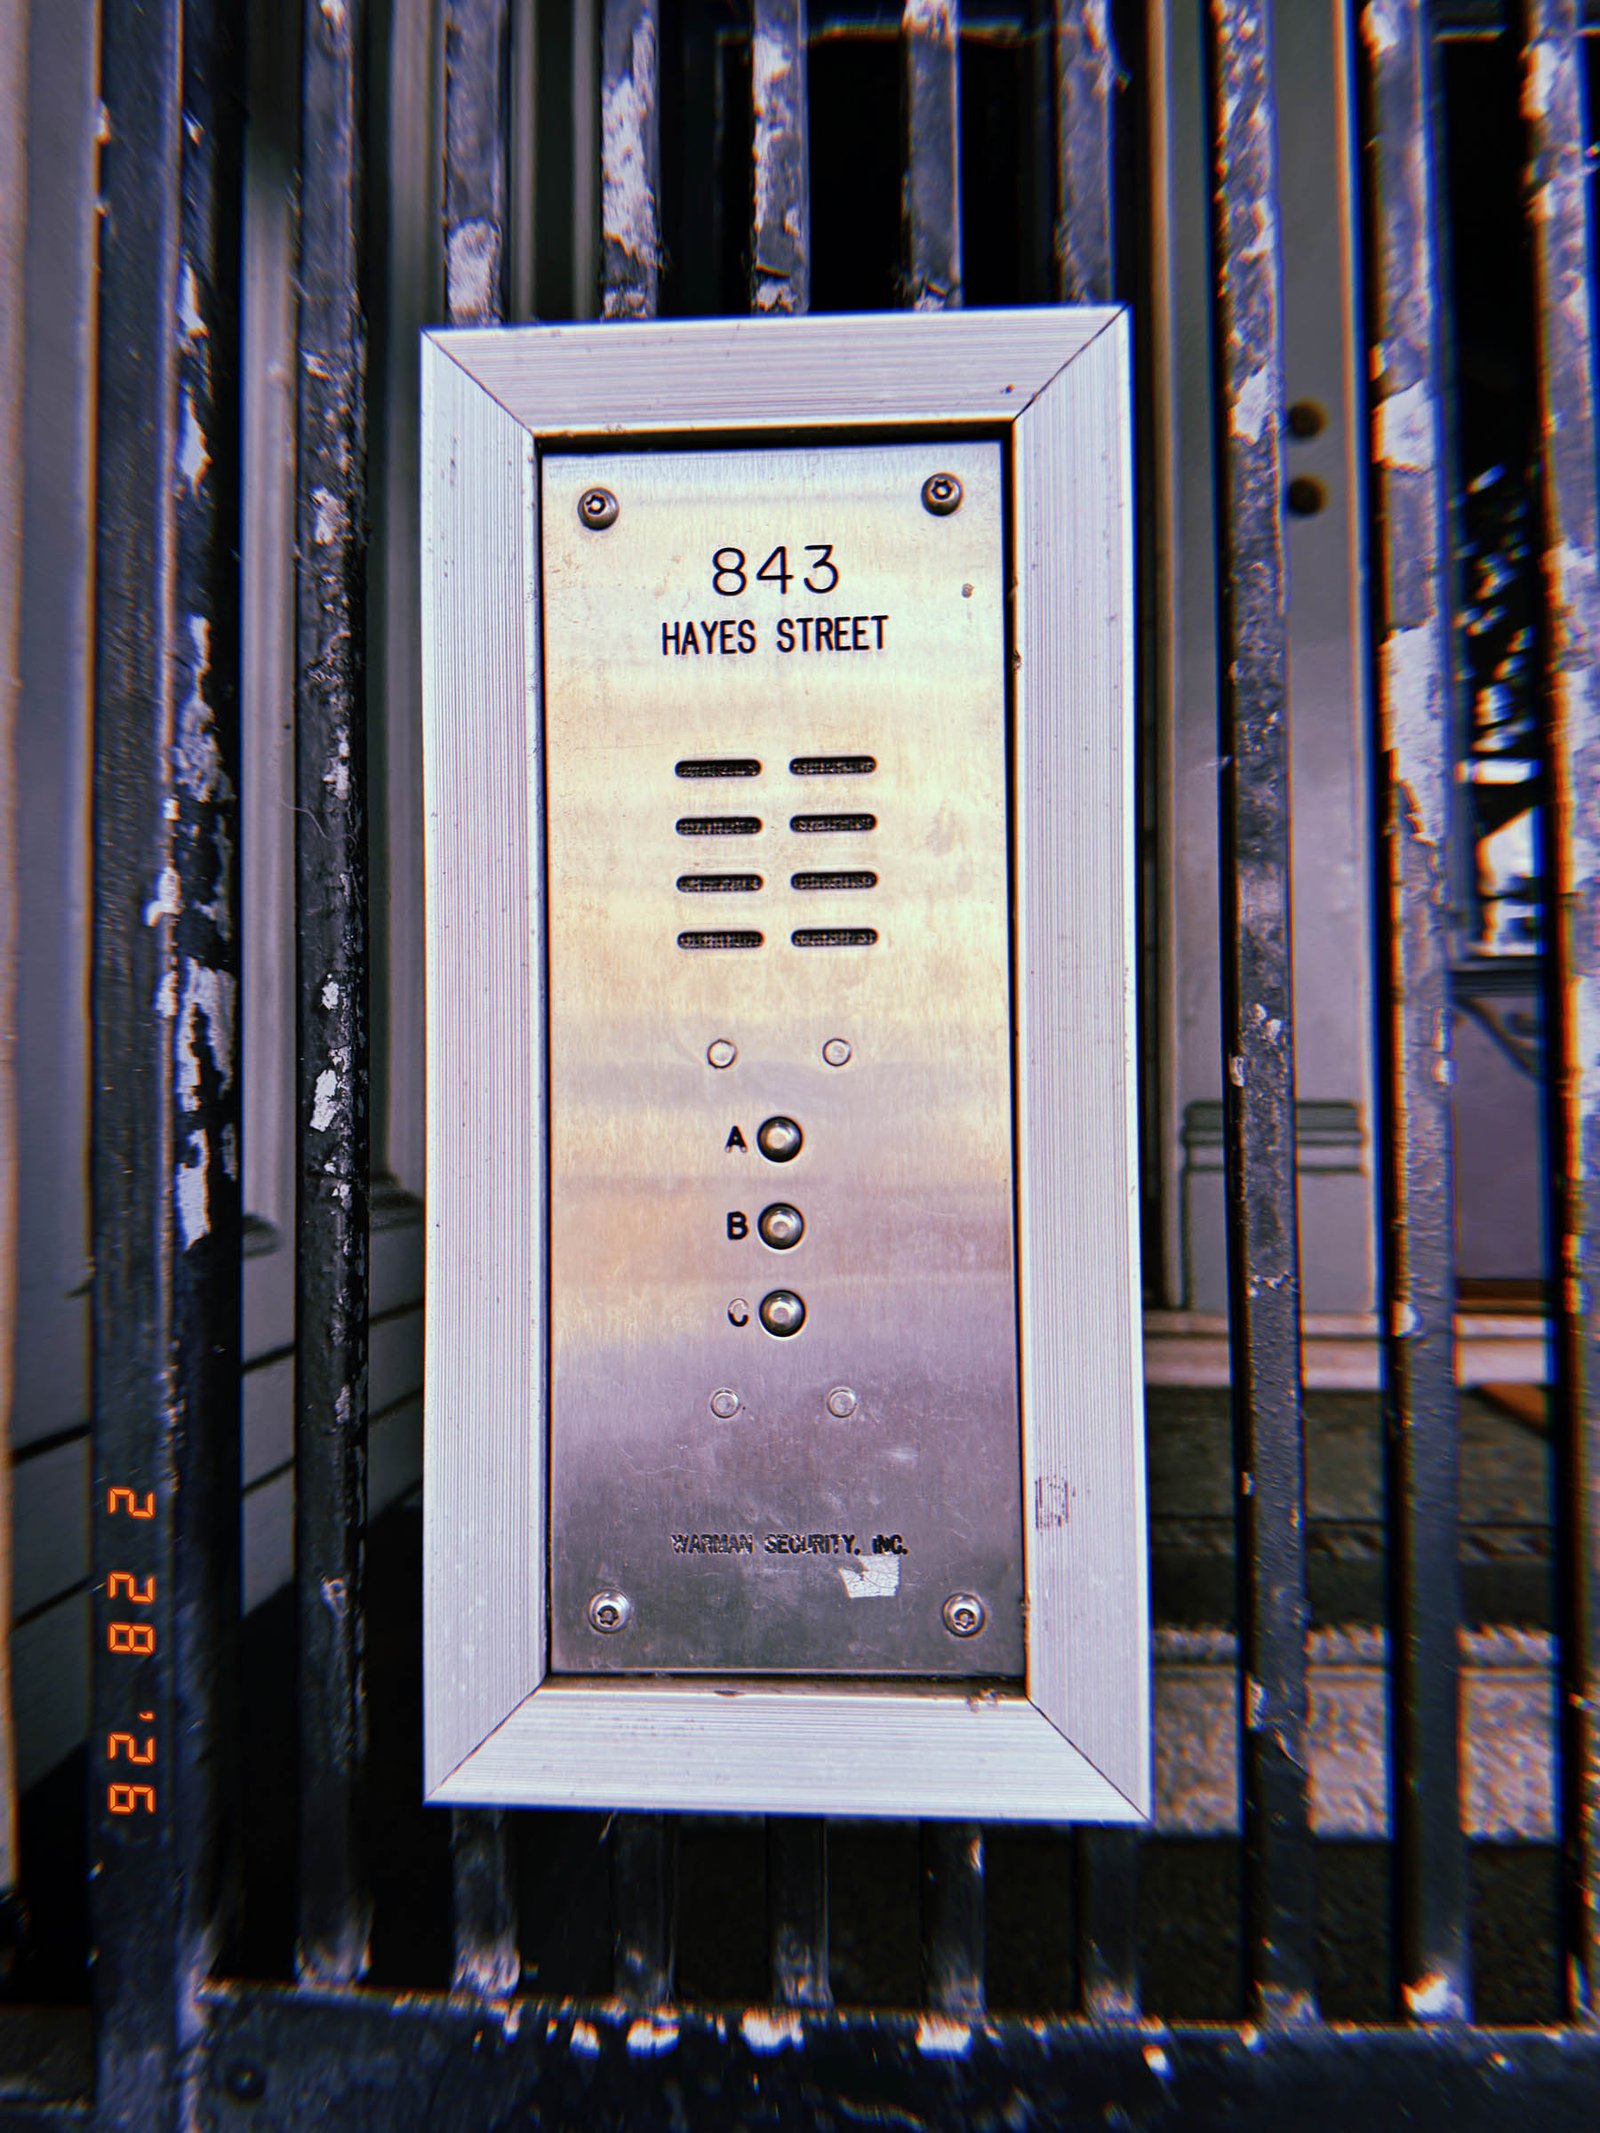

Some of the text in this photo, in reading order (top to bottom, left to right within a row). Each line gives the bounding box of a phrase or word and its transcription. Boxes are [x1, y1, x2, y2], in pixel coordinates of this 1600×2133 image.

[711, 544, 839, 596] 843
[661, 614, 889, 655] HAYES STREET
[724, 1124, 748, 1153] A
[726, 1211, 749, 1241] B
[727, 1297, 749, 1328] C
[671, 1534, 753, 1554] WARMAN
[872, 1534, 908, 1555] INC.
